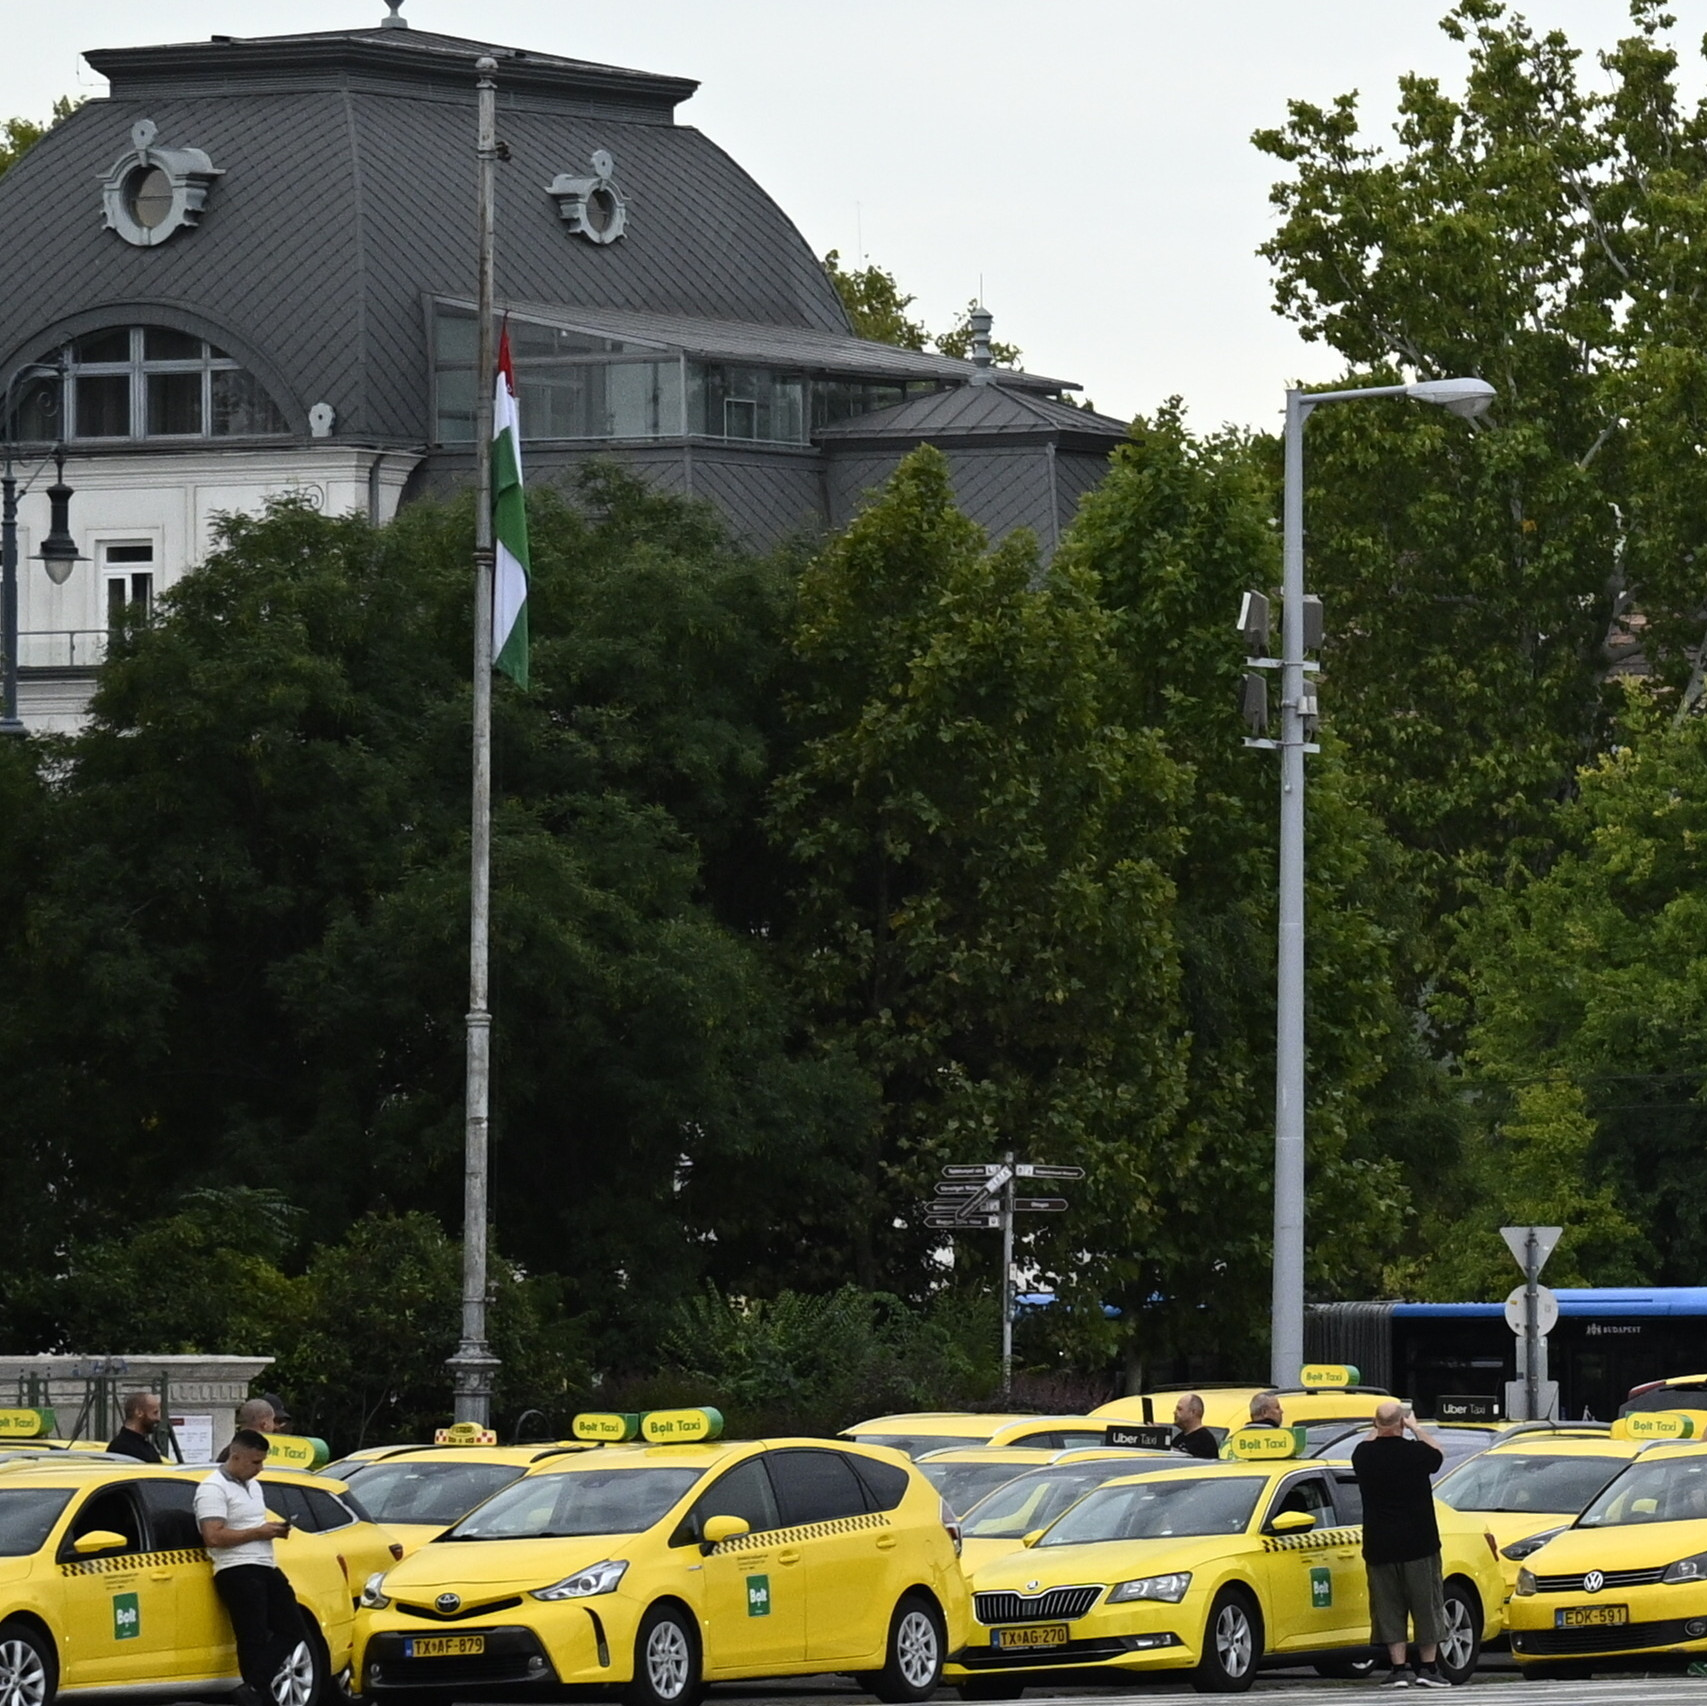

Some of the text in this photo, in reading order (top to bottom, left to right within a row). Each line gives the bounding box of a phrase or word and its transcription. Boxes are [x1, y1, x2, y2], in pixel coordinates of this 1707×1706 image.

[1603, 1326, 1641, 1334] BUDAPEST
[1306, 1372, 1342, 1383] Bolt Taxi
[1443, 1404, 1486, 1415] Uber Taxi
[14, 1417, 34, 1427] Taxi
[579, 1422, 619, 1433] Bolt Taxi
[650, 1418, 701, 1436] Bolt Taxi
[1633, 1420, 1677, 1433] Bolt Taxi
[1113, 1433, 1157, 1445] Uber Taxi
[1239, 1437, 1287, 1453] Bolt Taxi
[284, 1446, 306, 1459] Taxi
[1313, 1580, 1329, 1598] Bolt
[749, 1588, 768, 1606] Bolt
[116, 1608, 137, 1627] Bolt
[1565, 1609, 1622, 1625] EDK-591
